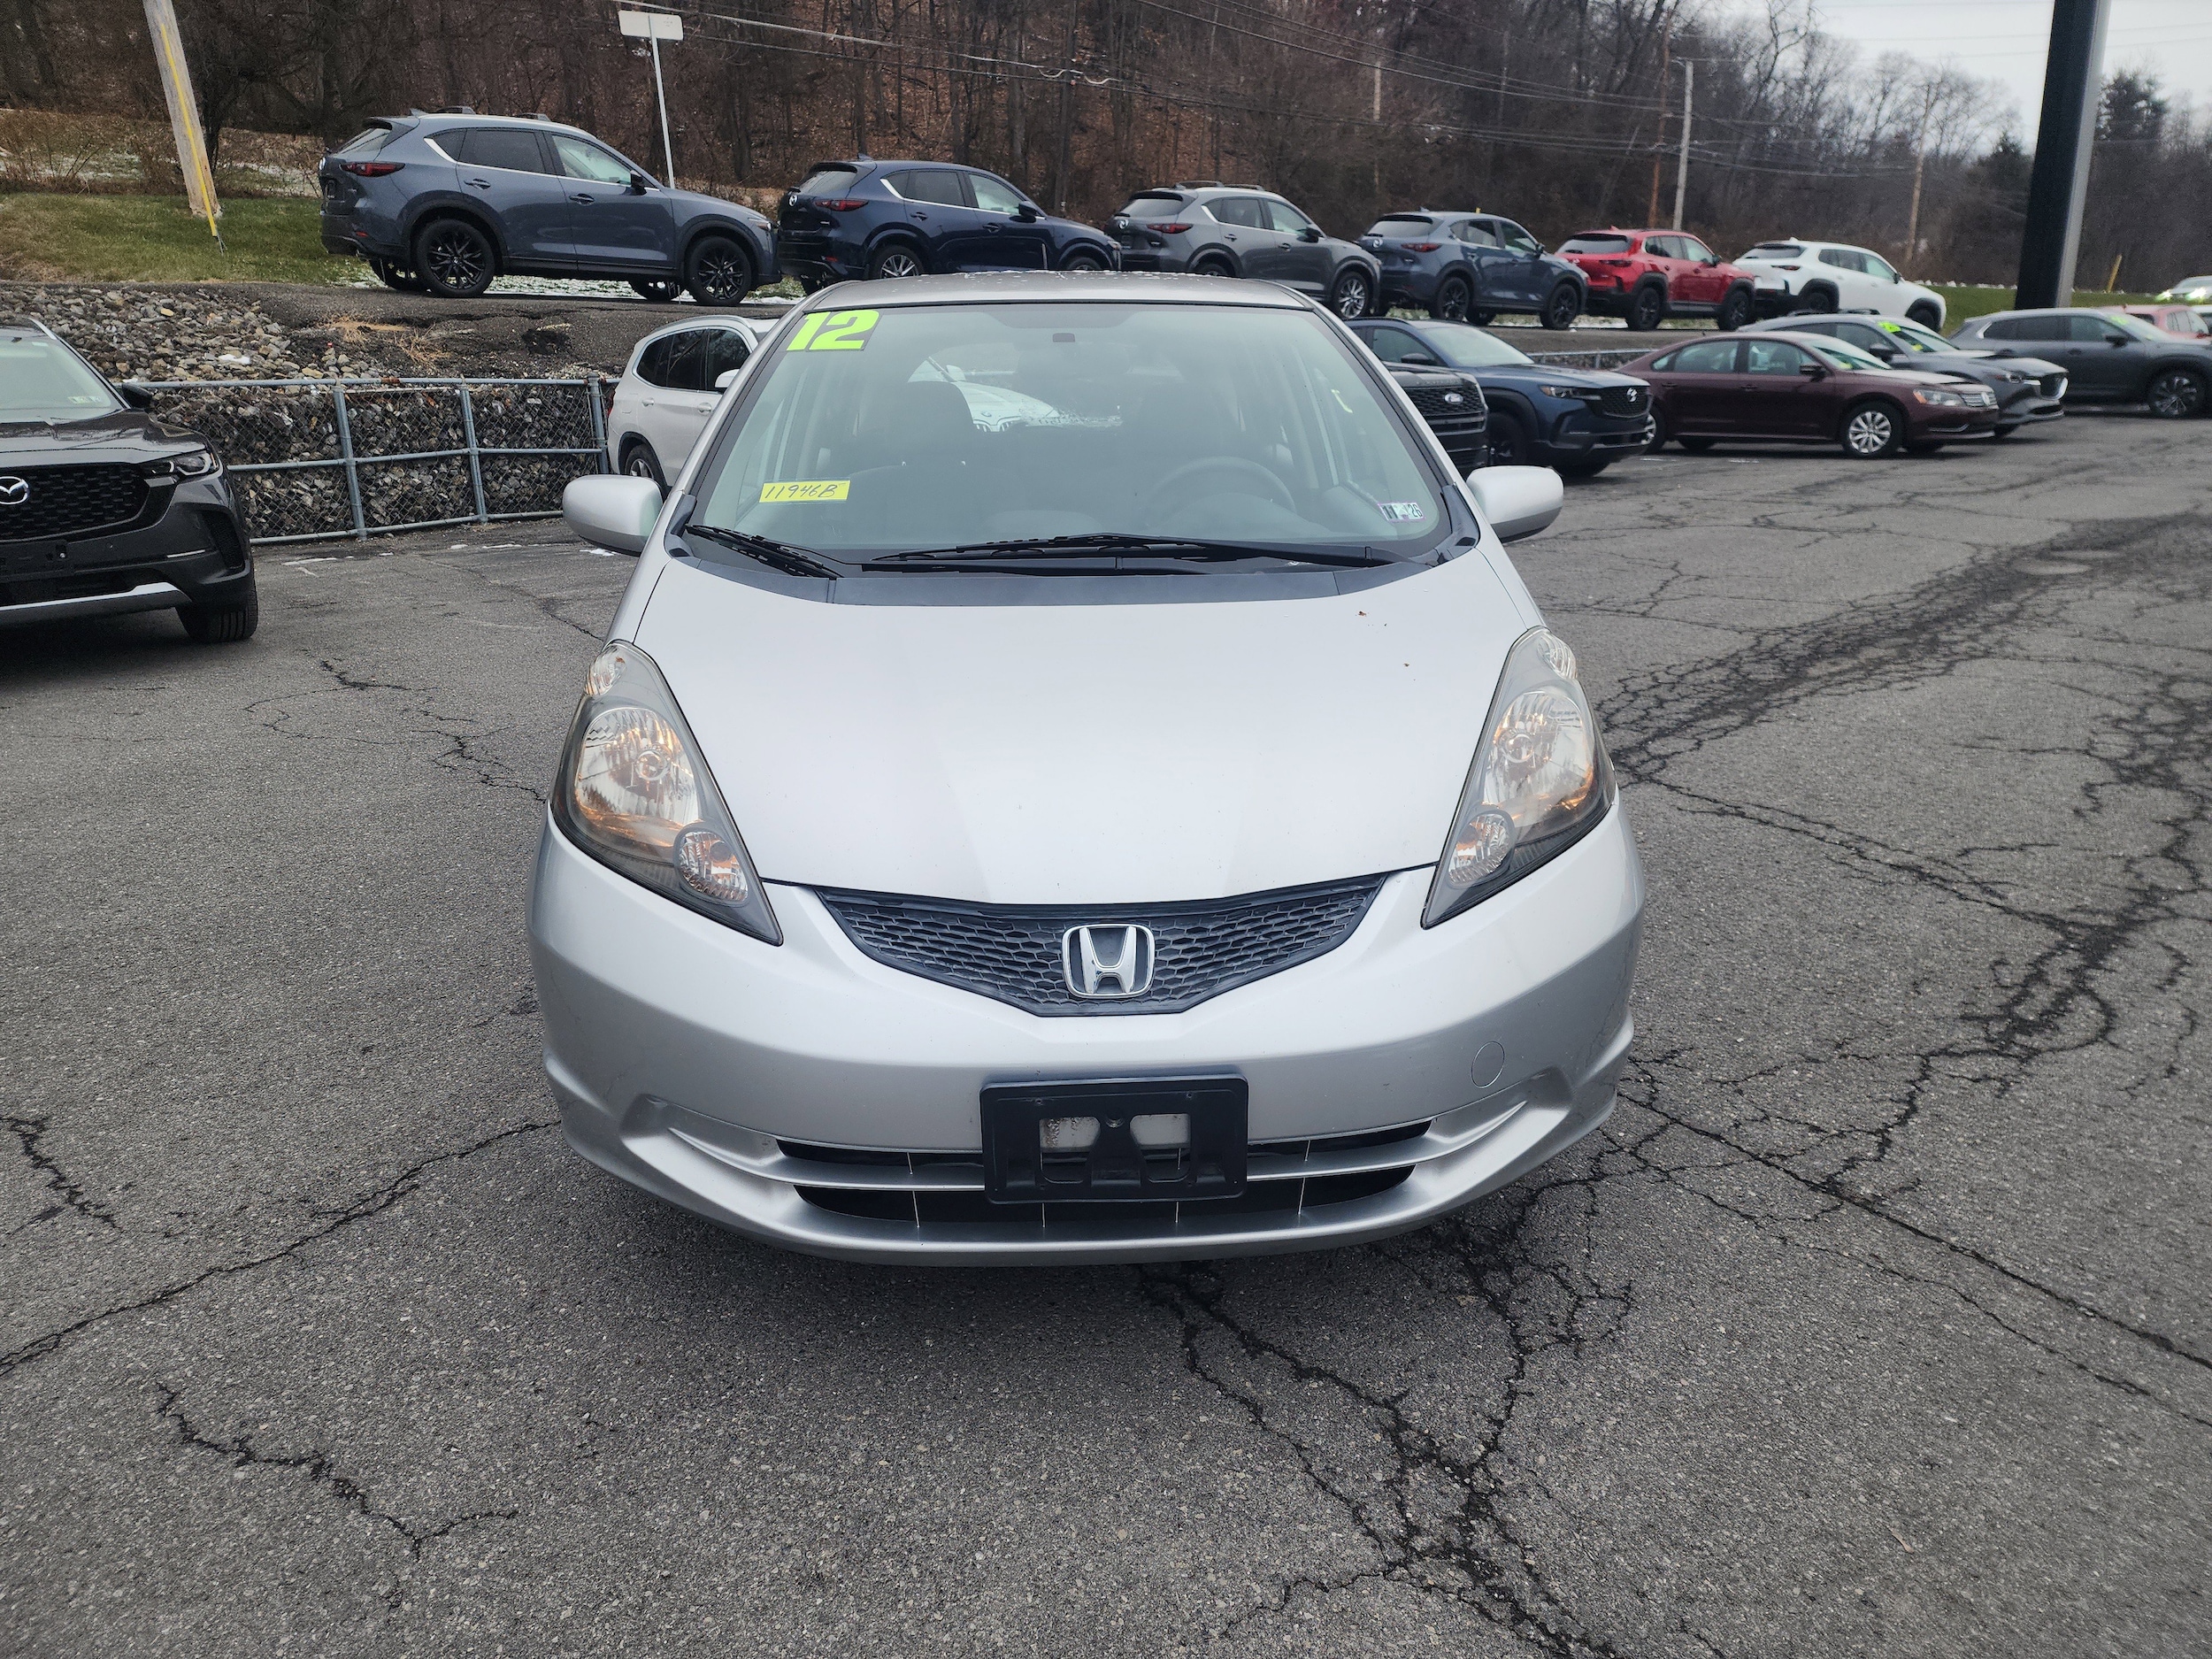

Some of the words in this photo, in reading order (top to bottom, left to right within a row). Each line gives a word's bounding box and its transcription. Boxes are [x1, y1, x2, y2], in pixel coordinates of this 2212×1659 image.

[787, 310, 879, 351] 12
[764, 484, 838, 499] 11946B
[1382, 504, 1398, 519] 11
[1408, 503, 1423, 518] 26
[1079, 926, 1138, 995] H
